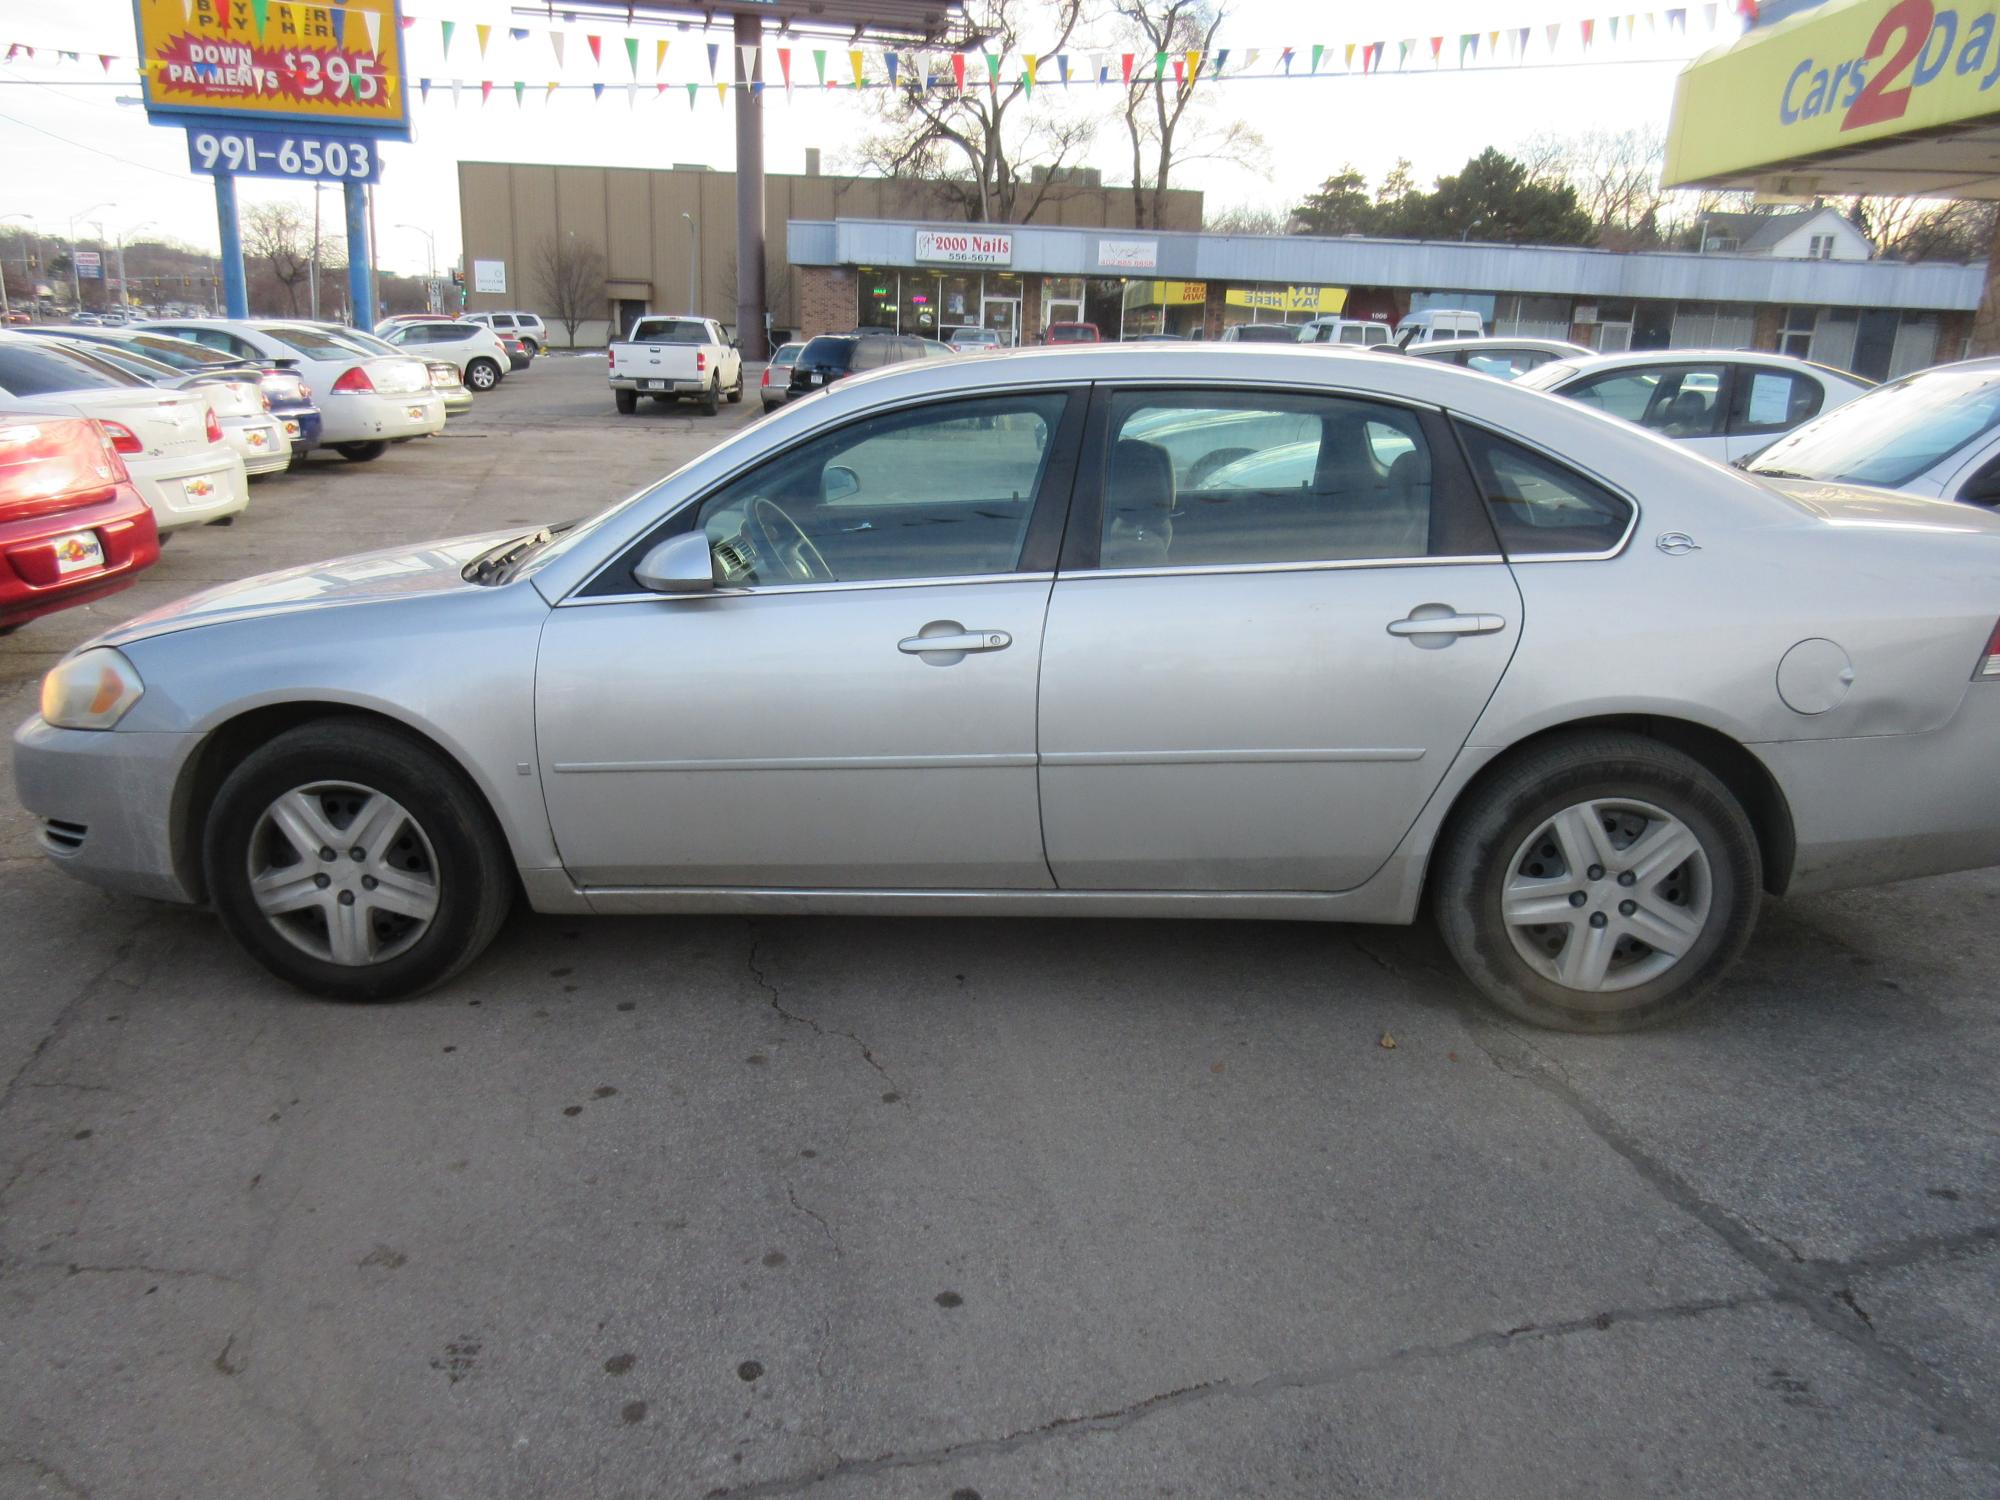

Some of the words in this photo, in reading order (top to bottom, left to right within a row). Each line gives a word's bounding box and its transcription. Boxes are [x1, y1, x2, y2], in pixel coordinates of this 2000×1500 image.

[197, 0, 248, 14] BY
[282, 21, 338, 38] HER
[189, 44, 253, 65] DOWN
[196, 134, 370, 178] 991-6503
[936, 236, 968, 252] 2000
[972, 236, 1010, 253] Nails
[949, 253, 995, 263] 556-5671
